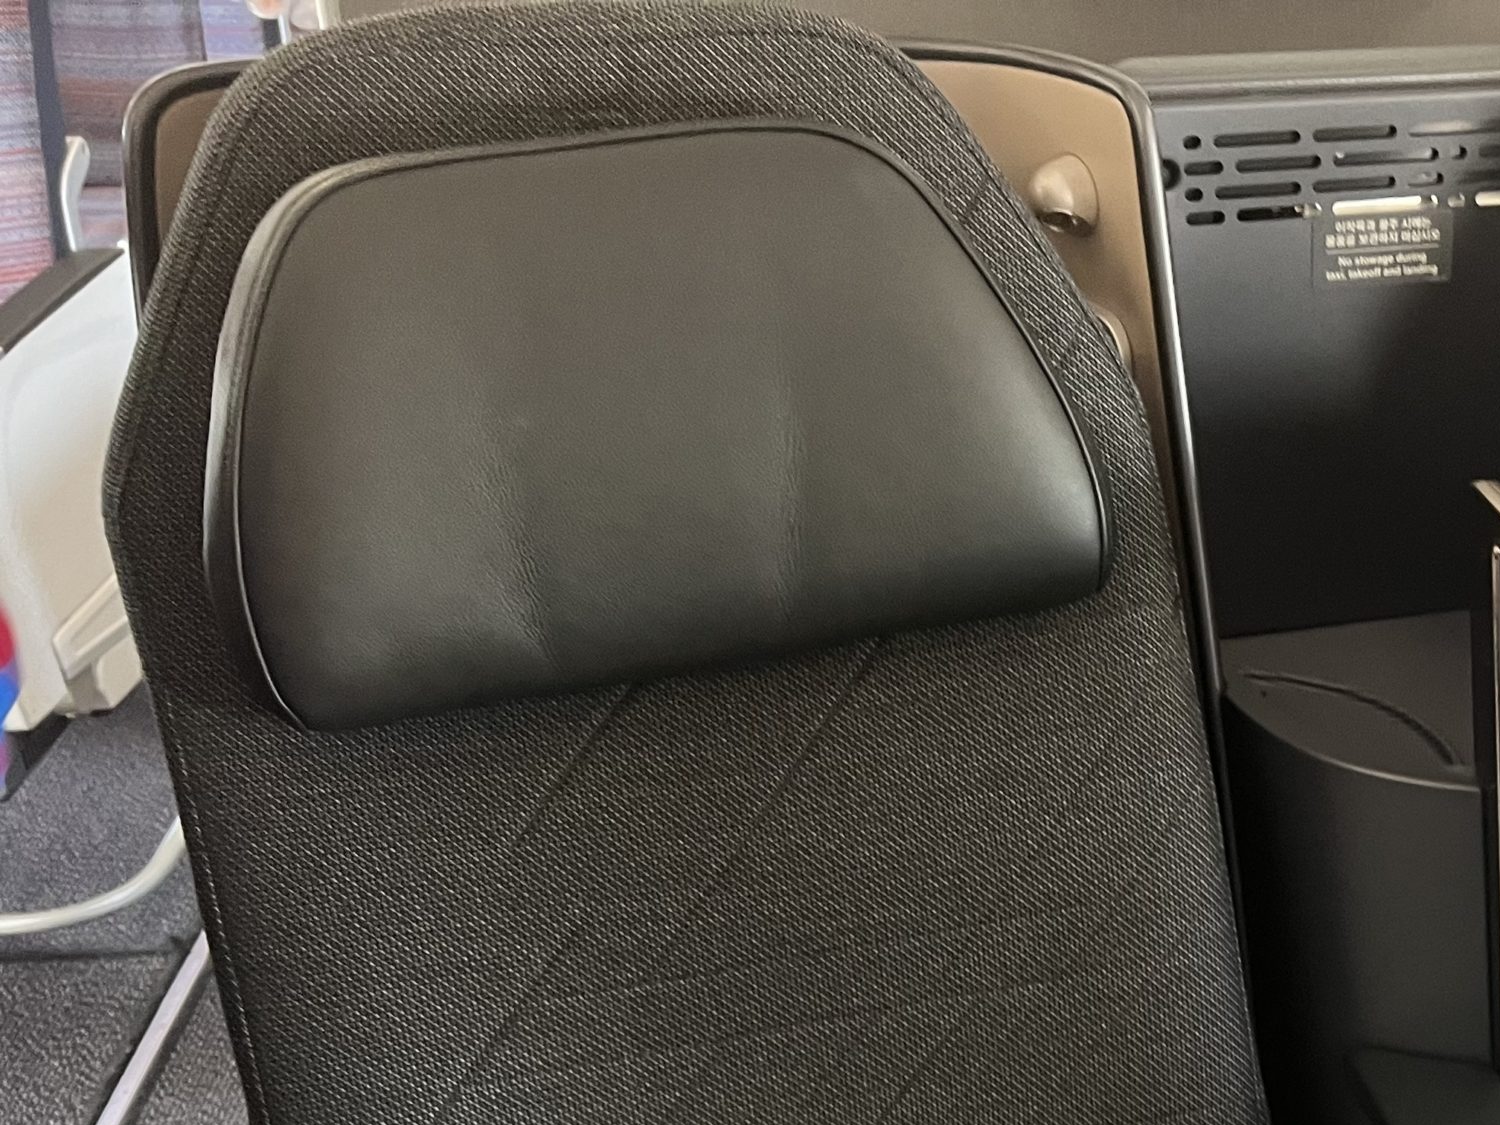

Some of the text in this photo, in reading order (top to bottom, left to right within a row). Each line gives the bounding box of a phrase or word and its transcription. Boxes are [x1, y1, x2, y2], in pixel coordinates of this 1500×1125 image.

[1338, 252, 1427, 267] No stowage during
[1348, 267, 1381, 280] takeoff
[1383, 266, 1402, 277] and
[1403, 265, 1438, 277] landing
